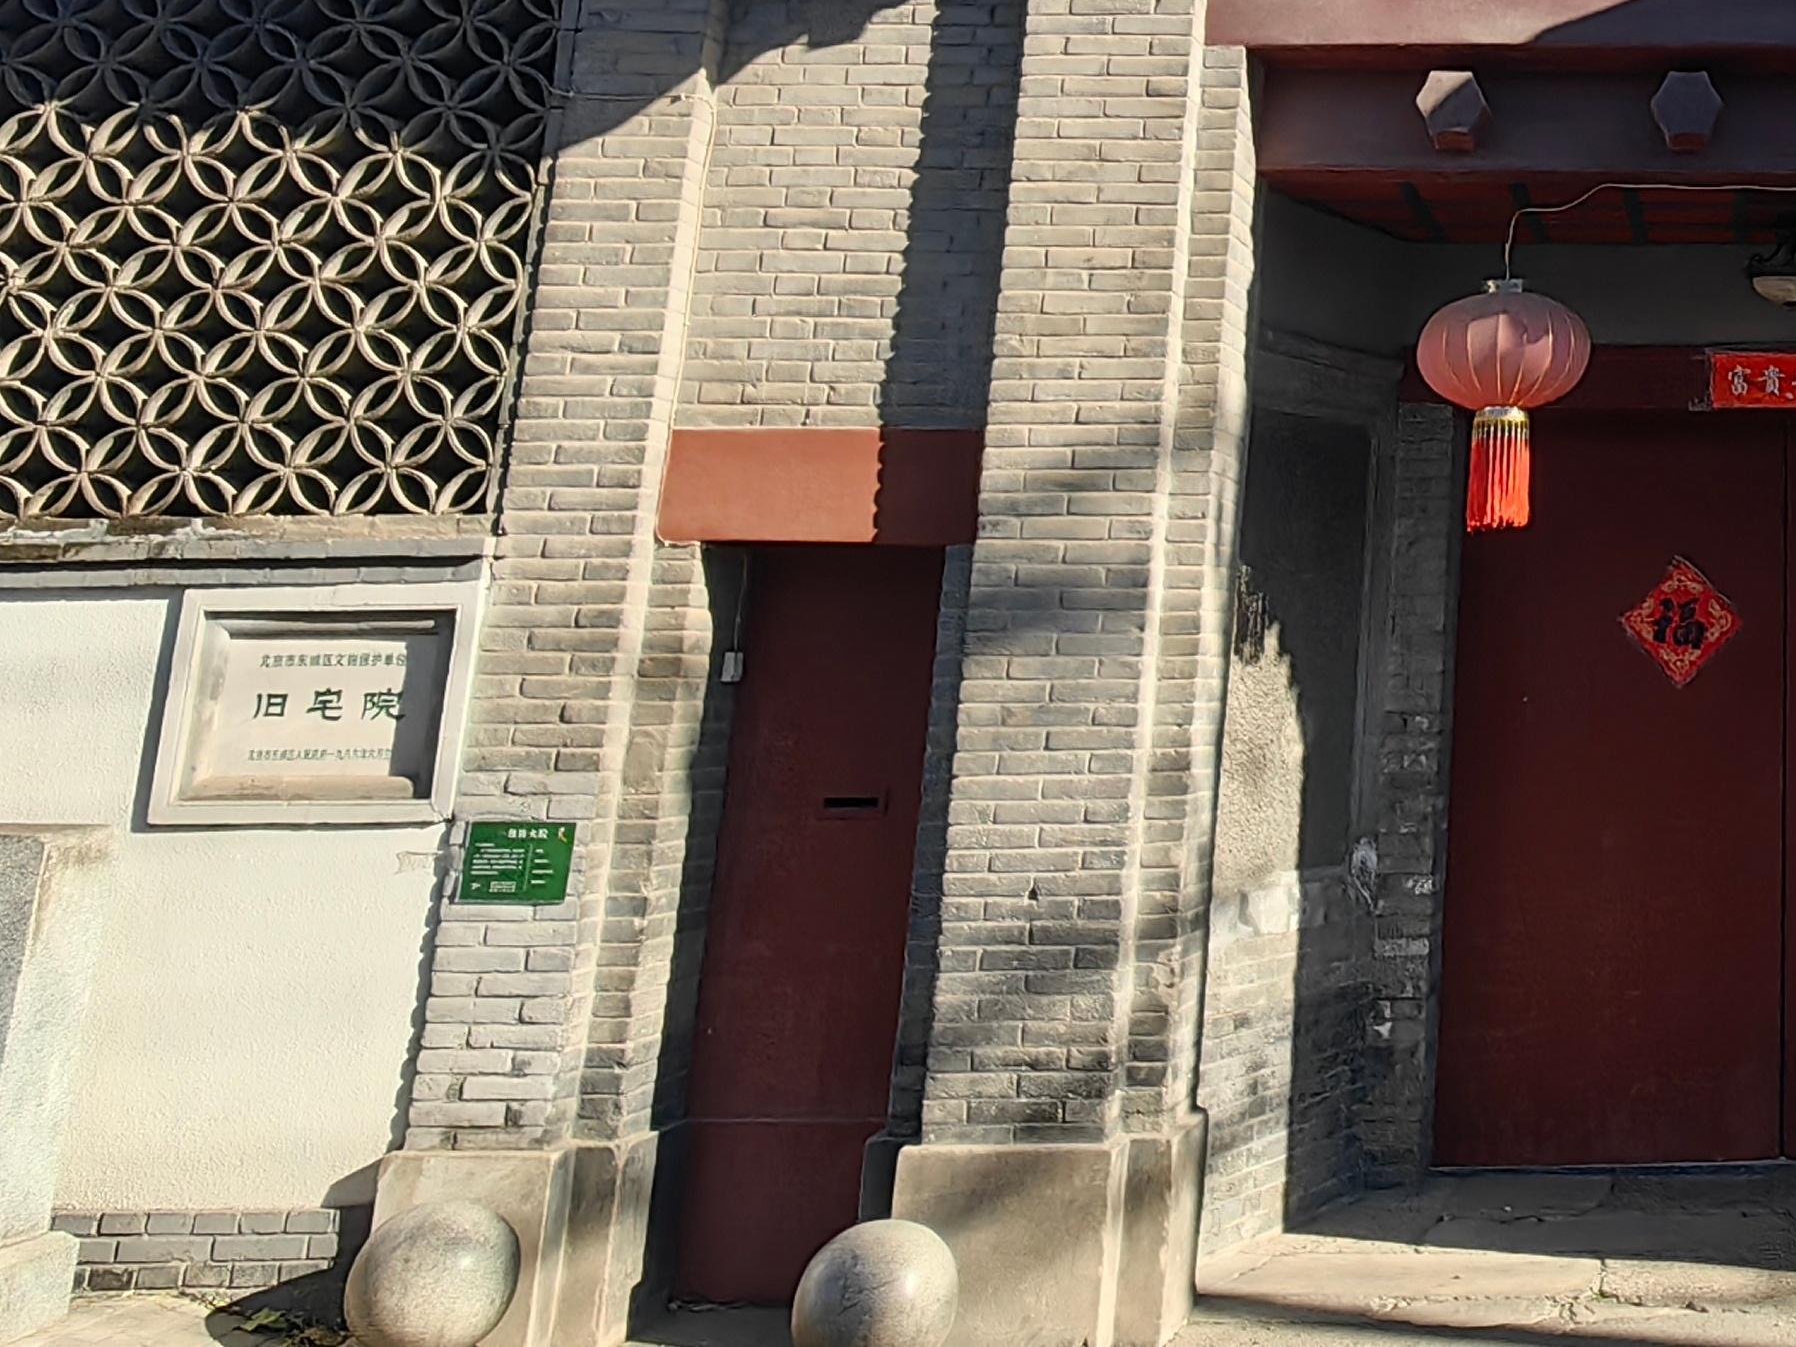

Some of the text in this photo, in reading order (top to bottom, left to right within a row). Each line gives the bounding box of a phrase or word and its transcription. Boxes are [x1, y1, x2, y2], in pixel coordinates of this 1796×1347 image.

[1652, 597, 1707, 650] 福
[253, 688, 405, 721] 旧宅院
